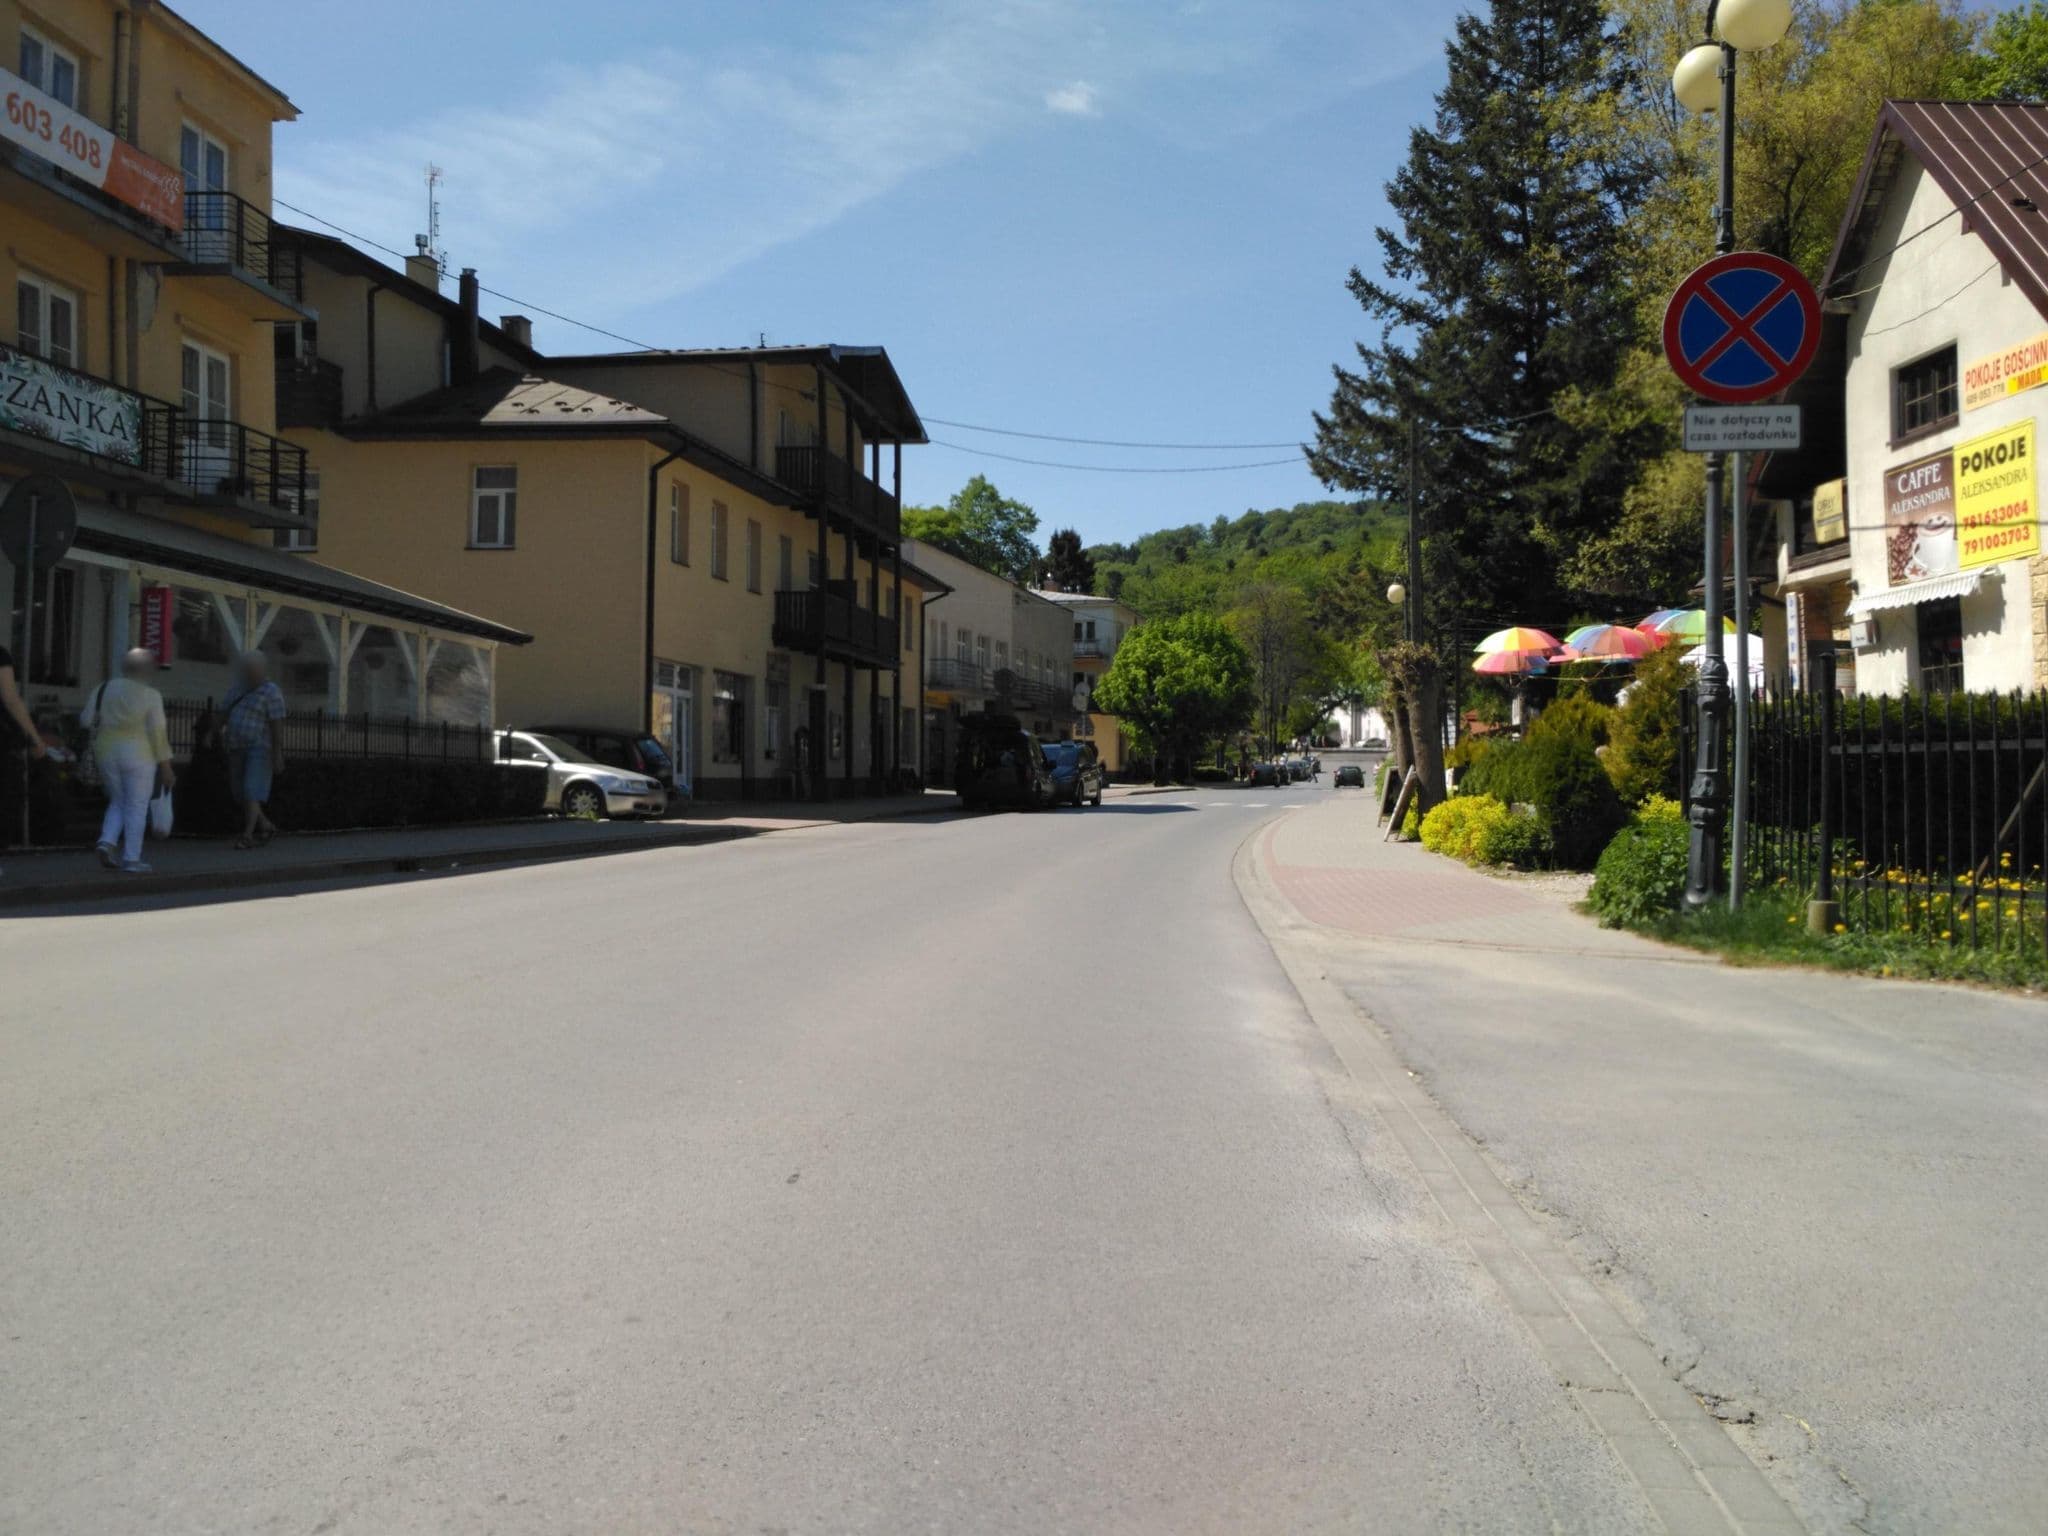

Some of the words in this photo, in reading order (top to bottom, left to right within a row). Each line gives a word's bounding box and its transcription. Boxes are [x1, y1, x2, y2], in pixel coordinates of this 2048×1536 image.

[6, 91, 52, 142] 603
[59, 123, 101, 169] 408
[1965, 358, 2000, 392] POKOJE
[1690, 431, 1717, 441] czas
[1694, 415, 1715, 425] Nie
[1721, 413, 1771, 427] dotyczy
[1776, 415, 1793, 424] na
[1961, 436, 2026, 478] POKOJE
[1897, 462, 1942, 494] CAFFE
[1961, 467, 2028, 500] ALEKSANDRA
[1890, 486, 1951, 516] ALEKSANDRA
